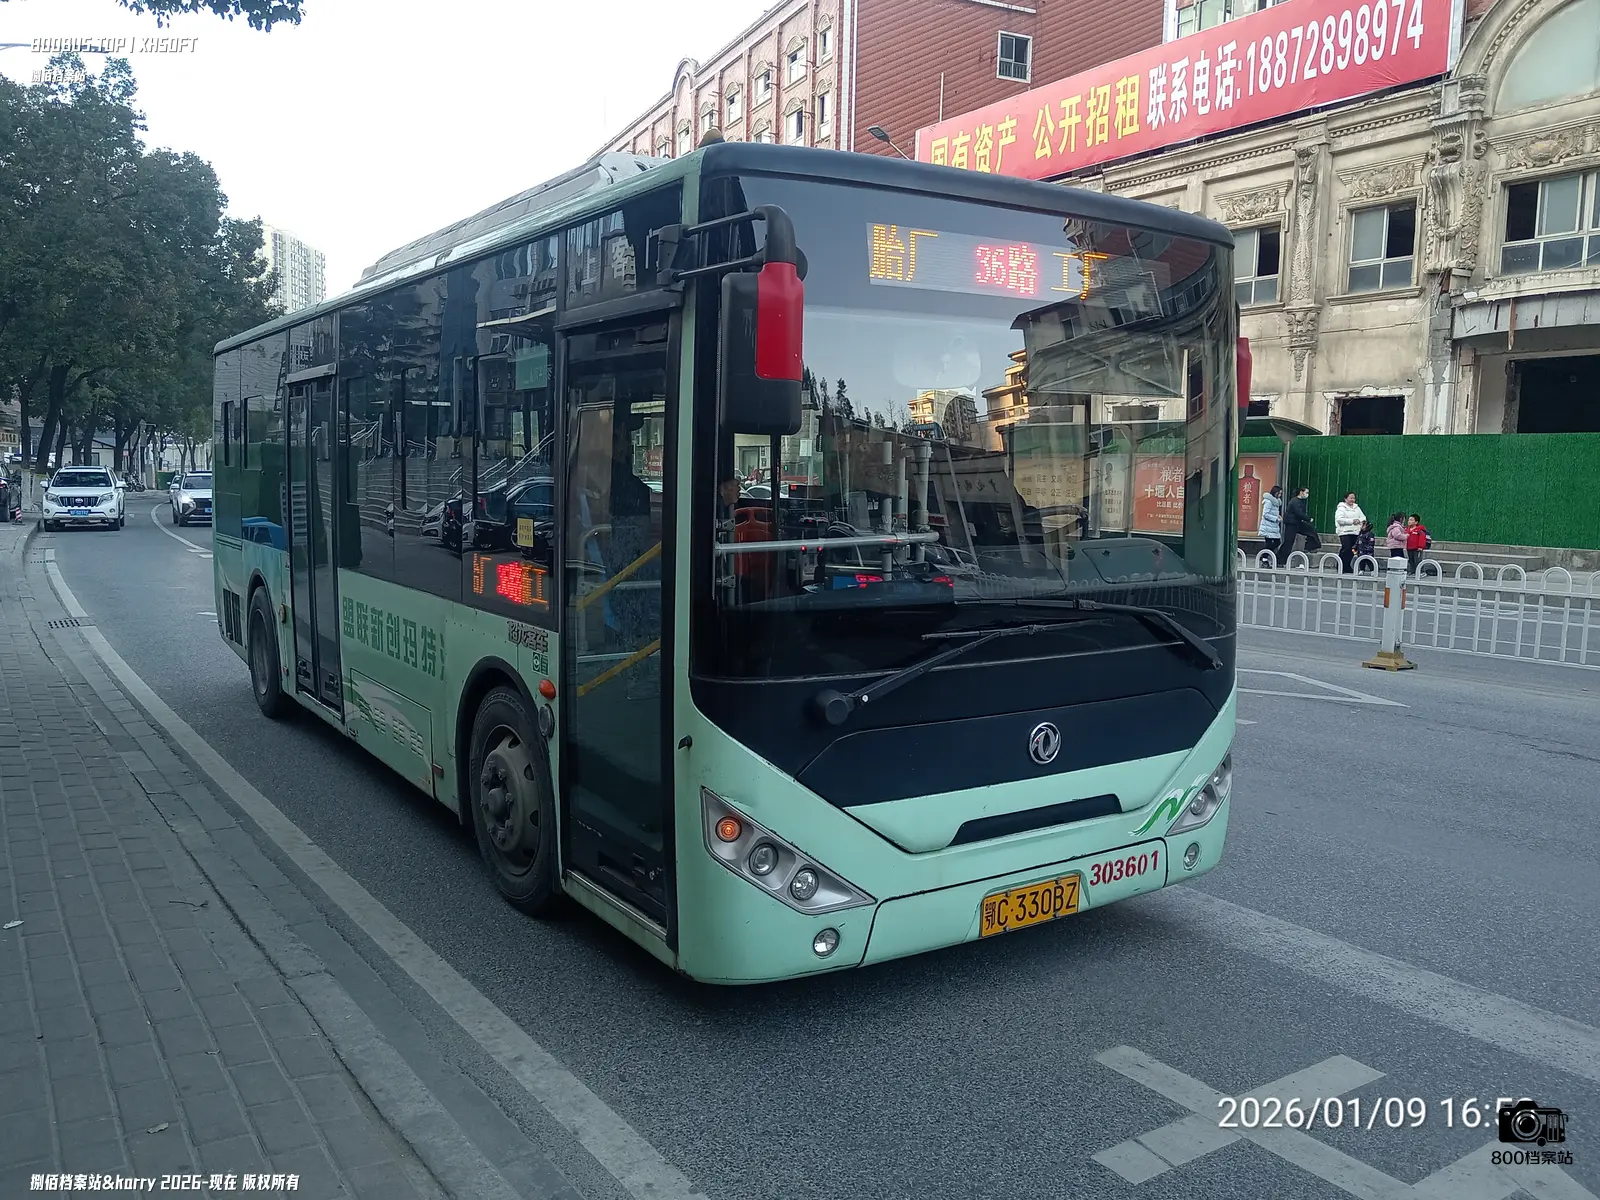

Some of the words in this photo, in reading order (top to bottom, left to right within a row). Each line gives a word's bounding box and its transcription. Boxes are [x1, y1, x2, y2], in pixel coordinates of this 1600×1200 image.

[1032, 75, 1140, 161] 公开招租
[1146, 0, 1424, 130] 联系电话:18872898974
[975, 244, 1038, 295] 36路
[1090, 850, 1159, 887] 303601
